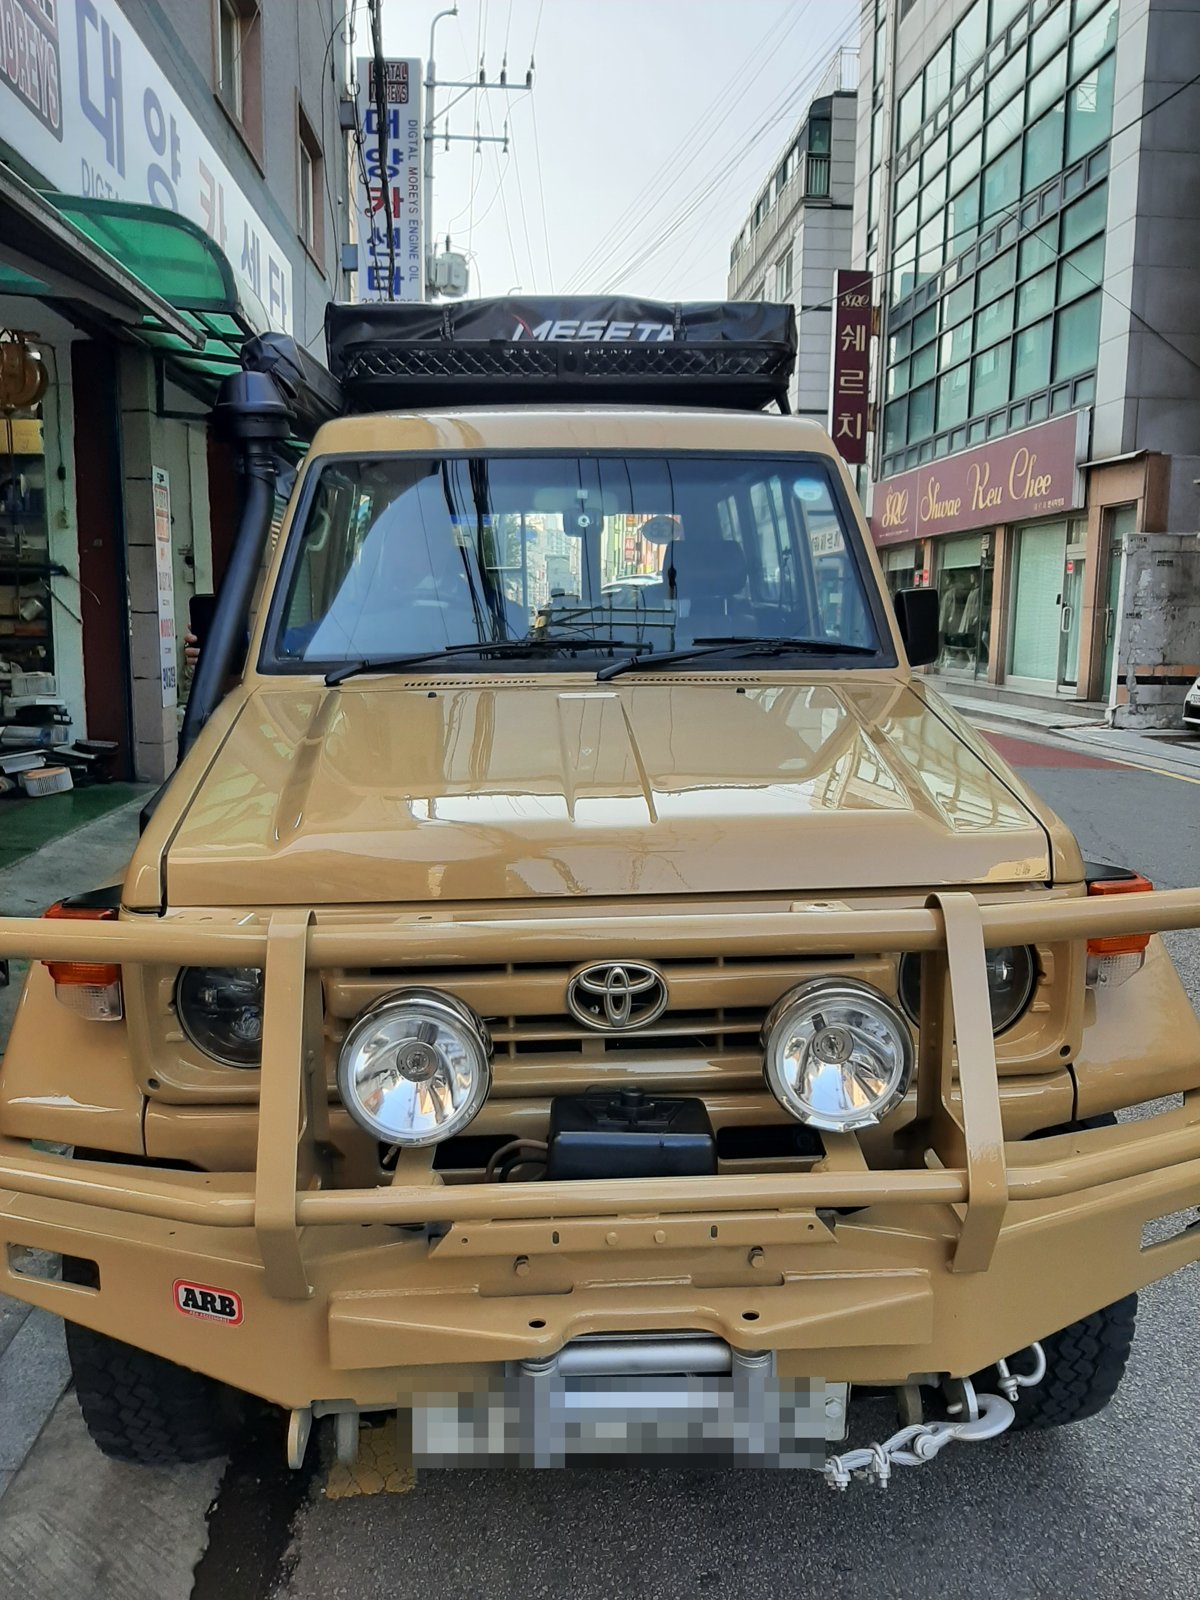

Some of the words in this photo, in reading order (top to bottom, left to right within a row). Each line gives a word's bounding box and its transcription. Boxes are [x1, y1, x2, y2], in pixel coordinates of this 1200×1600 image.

[407, 119, 419, 161] DIGTAL
[408, 166, 419, 213] MOREYS
[408, 219, 419, 260] ENGINE
[409, 264, 419, 283] OIL
[510, 314, 674, 341] MESETA
[836, 324, 866, 440] 쉐르치
[1008, 447, 1052, 500] Chee
[182, 1287, 237, 1317] ARB
